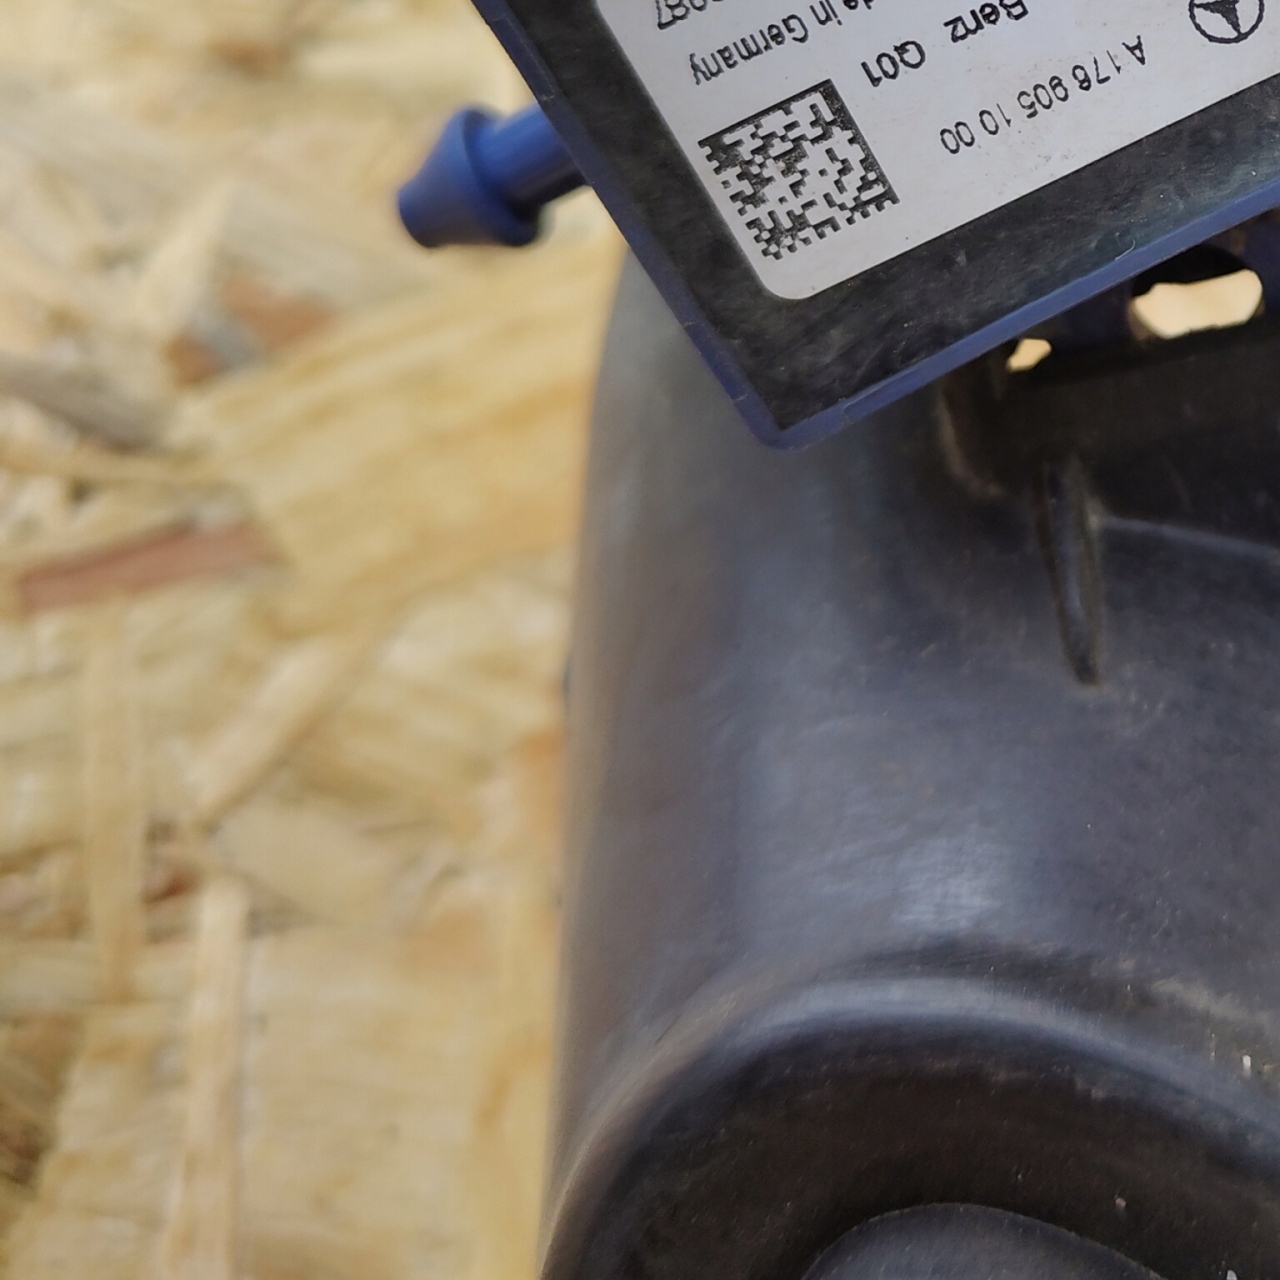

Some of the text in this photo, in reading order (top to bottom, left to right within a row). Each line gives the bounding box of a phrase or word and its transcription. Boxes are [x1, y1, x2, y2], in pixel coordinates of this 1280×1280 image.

[688, 13, 809, 86] Germany
[860, 40, 926, 88] Q01
[939, 34, 1146, 155] A 176 905 10 00
